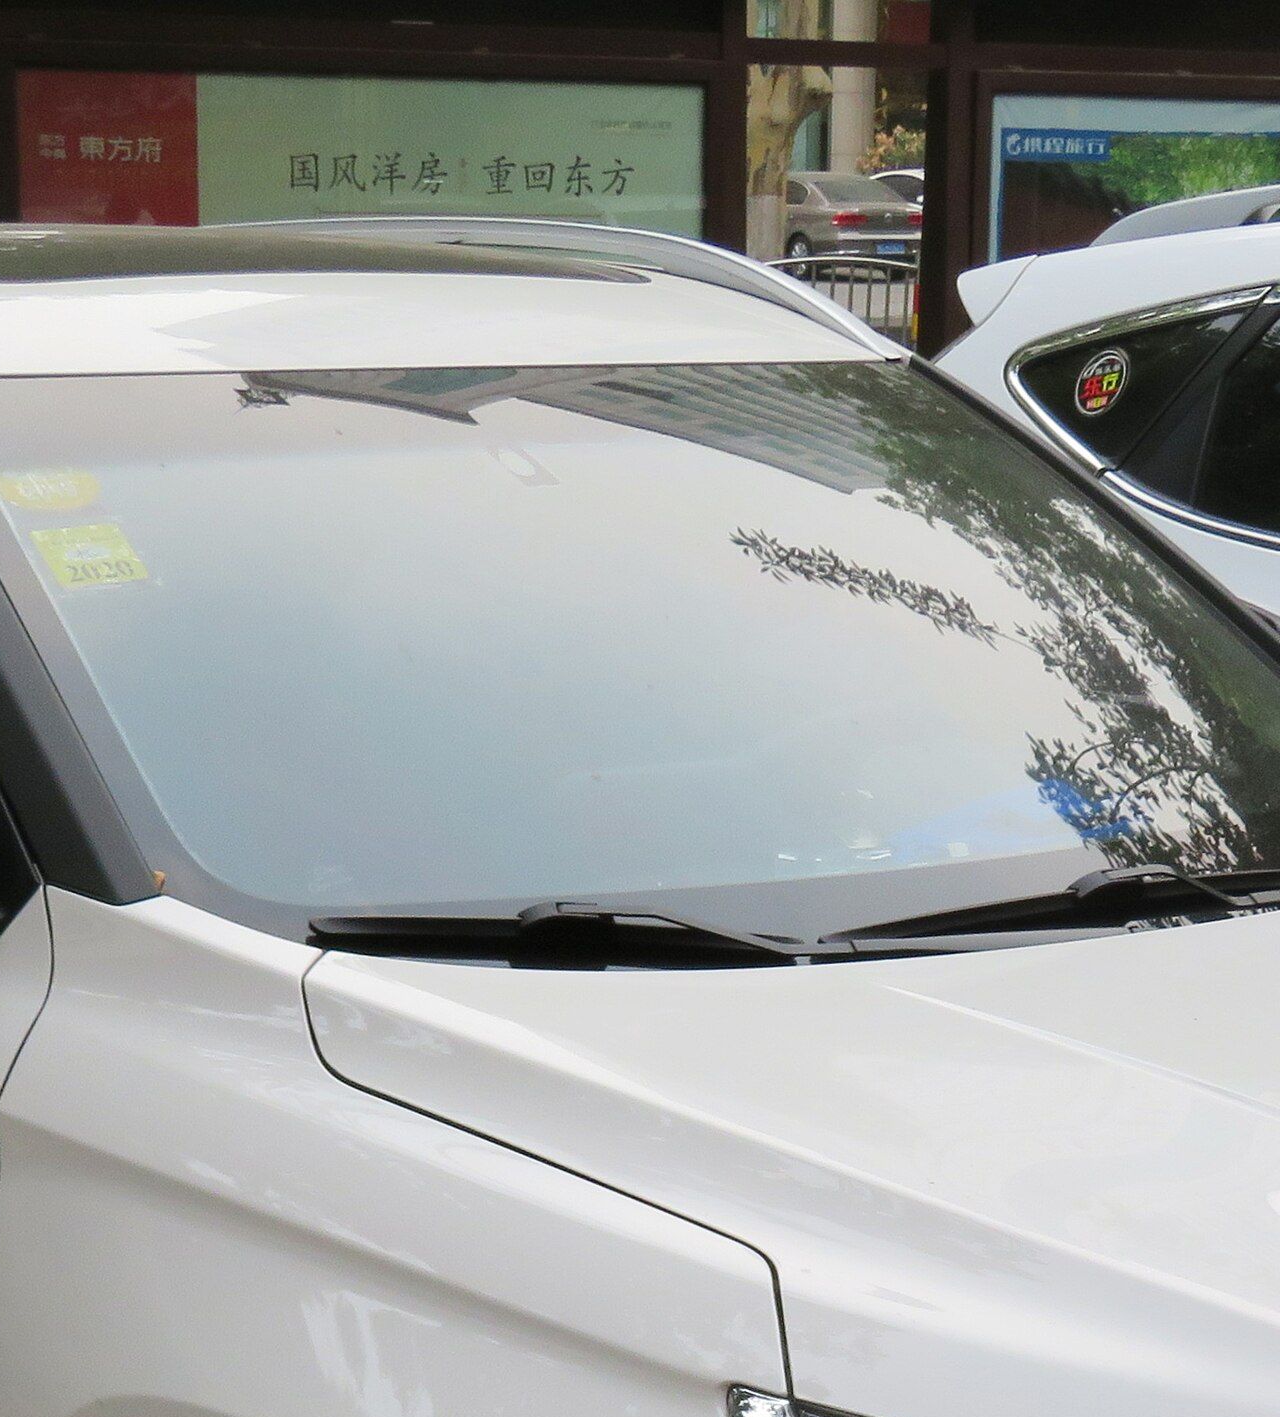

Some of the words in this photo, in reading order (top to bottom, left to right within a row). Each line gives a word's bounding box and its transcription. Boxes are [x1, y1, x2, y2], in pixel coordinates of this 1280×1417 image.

[79, 135, 162, 163] 東方府
[289, 151, 448, 196] 国风洋房
[481, 154, 635, 197] 重回东方
